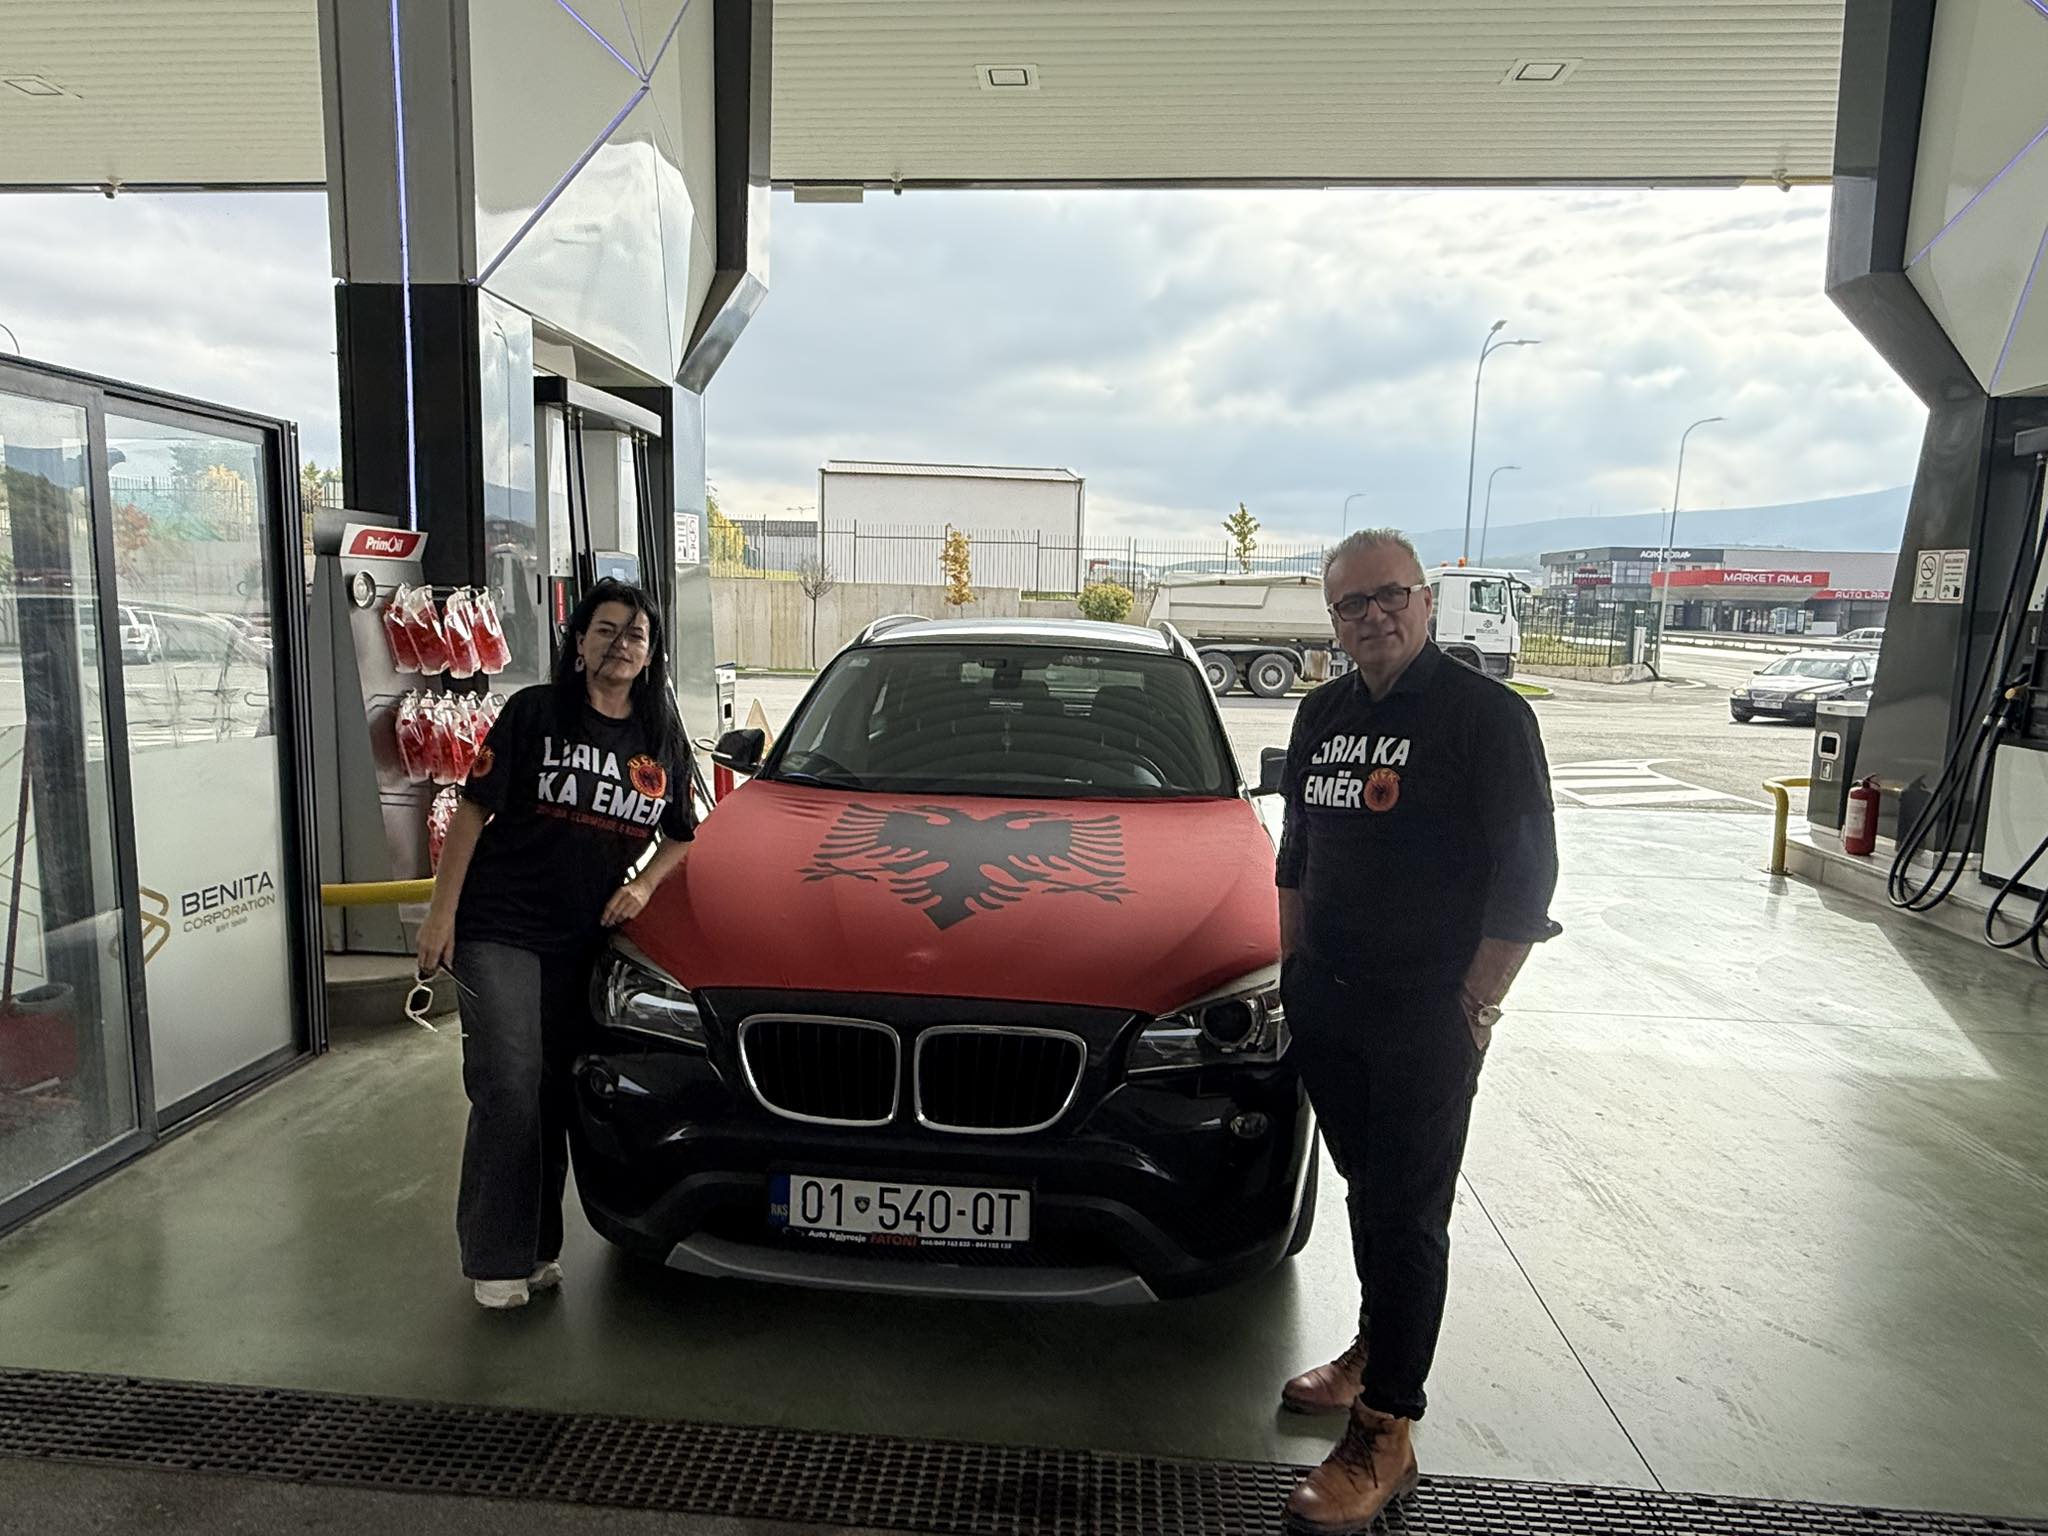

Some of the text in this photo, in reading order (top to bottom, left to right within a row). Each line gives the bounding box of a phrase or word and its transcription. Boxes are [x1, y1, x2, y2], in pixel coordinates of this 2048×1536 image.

[365, 535, 404, 553] PrimOil
[1723, 572, 1813, 584] MARKET AMLA
[1834, 591, 1862, 599] AUTO
[1371, 736, 1411, 766] KA
[538, 771, 578, 807] KA
[1304, 770, 1364, 809] EMËR
[181, 871, 275, 917] BENITA
[183, 893, 276, 933] CORPORATION
[770, 1202, 789, 1217] RKS
[801, 1180, 1021, 1237] 01 540-QT
[808, 1230, 828, 1239] Auto
[870, 1233, 917, 1247] FATONI
